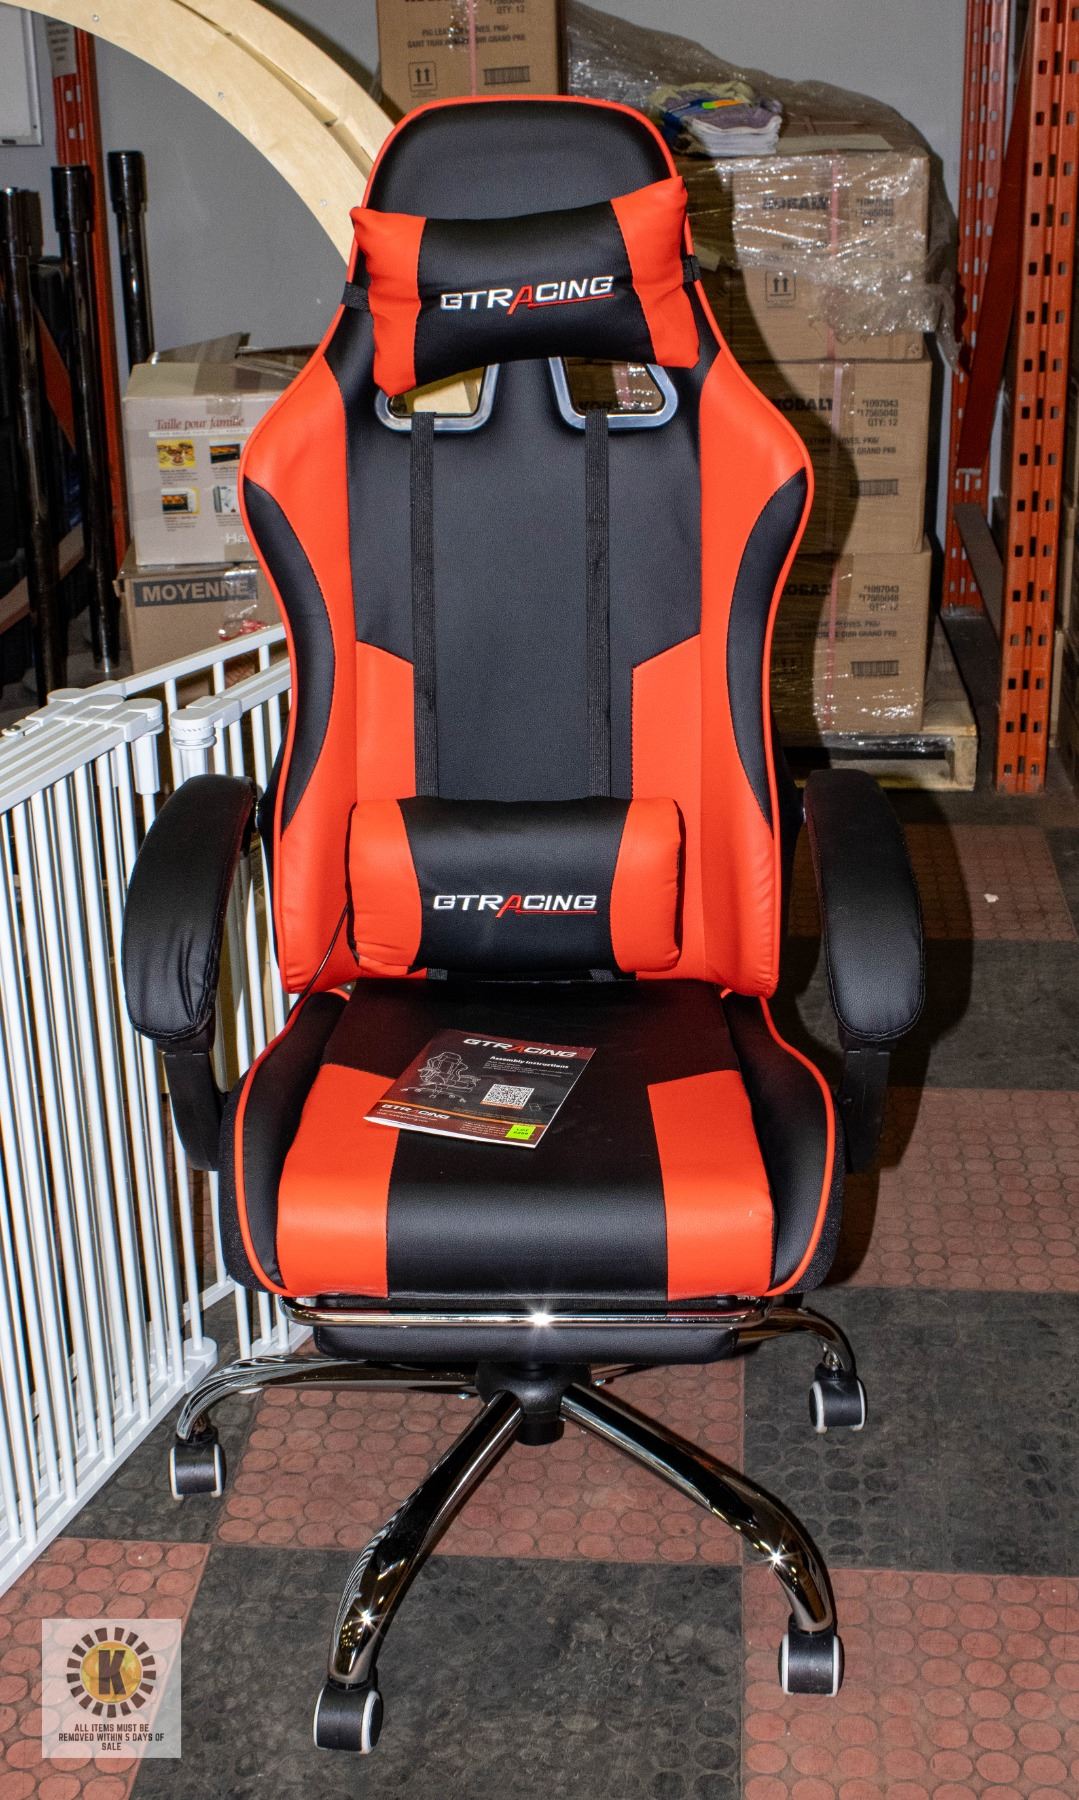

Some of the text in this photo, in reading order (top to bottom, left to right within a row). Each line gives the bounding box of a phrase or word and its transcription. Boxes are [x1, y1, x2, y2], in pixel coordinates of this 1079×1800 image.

[440, 276, 615, 315] GTRACING
[156, 416, 245, 431] Taille pour famille
[888, 418, 898, 426] 12
[142, 580, 249, 602] MOYENNE
[433, 893, 597, 918] GTRACING
[463, 1038, 577, 1058] GTRACING
[490, 1055, 525, 1065] Assembly
[381, 1103, 450, 1120] GTRACING
